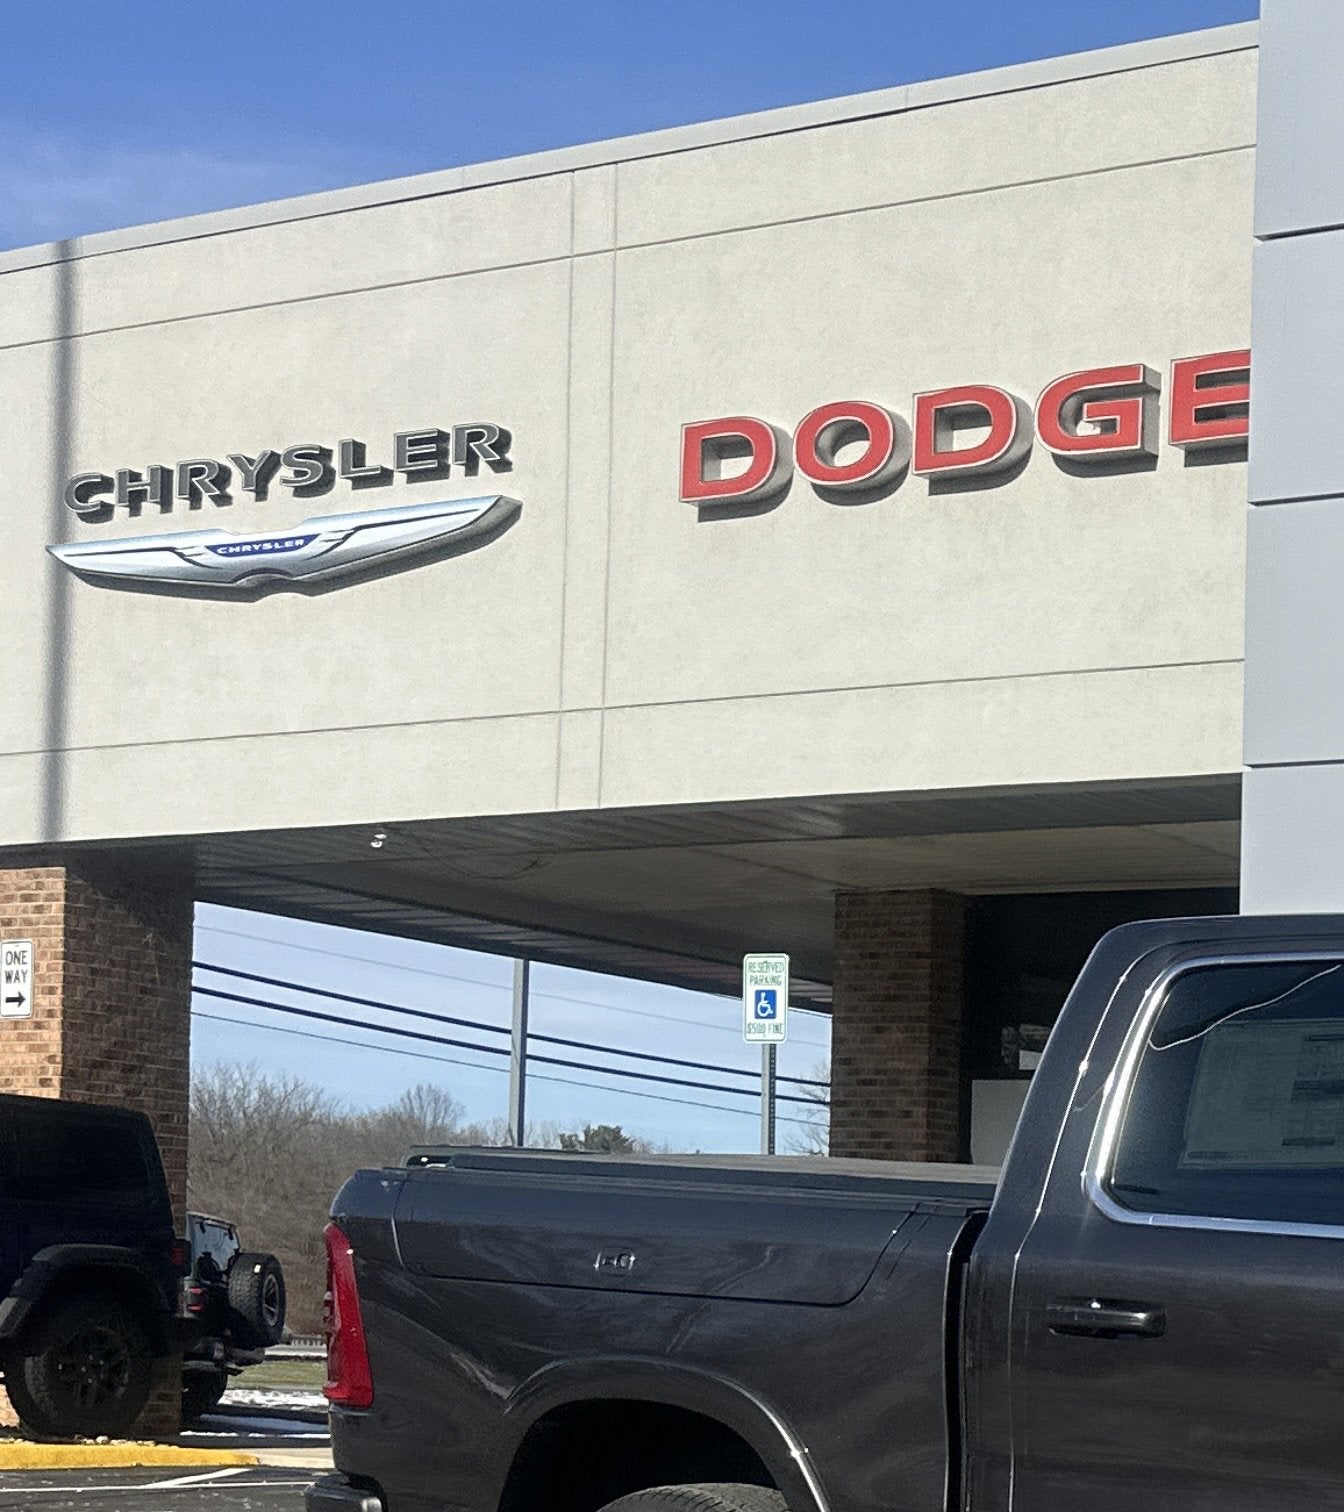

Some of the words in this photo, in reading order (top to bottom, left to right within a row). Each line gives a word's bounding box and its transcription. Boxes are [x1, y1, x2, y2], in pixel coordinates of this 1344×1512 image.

[680, 349, 1250, 508] DODGE
[64, 422, 509, 517] CHRYSLER
[217, 538, 305, 554] CHRYSLER
[5, 950, 28, 966] ONE
[748, 961, 785, 973] RESERVED
[4, 969, 28, 984] WAY
[749, 974, 782, 986] PARKING
